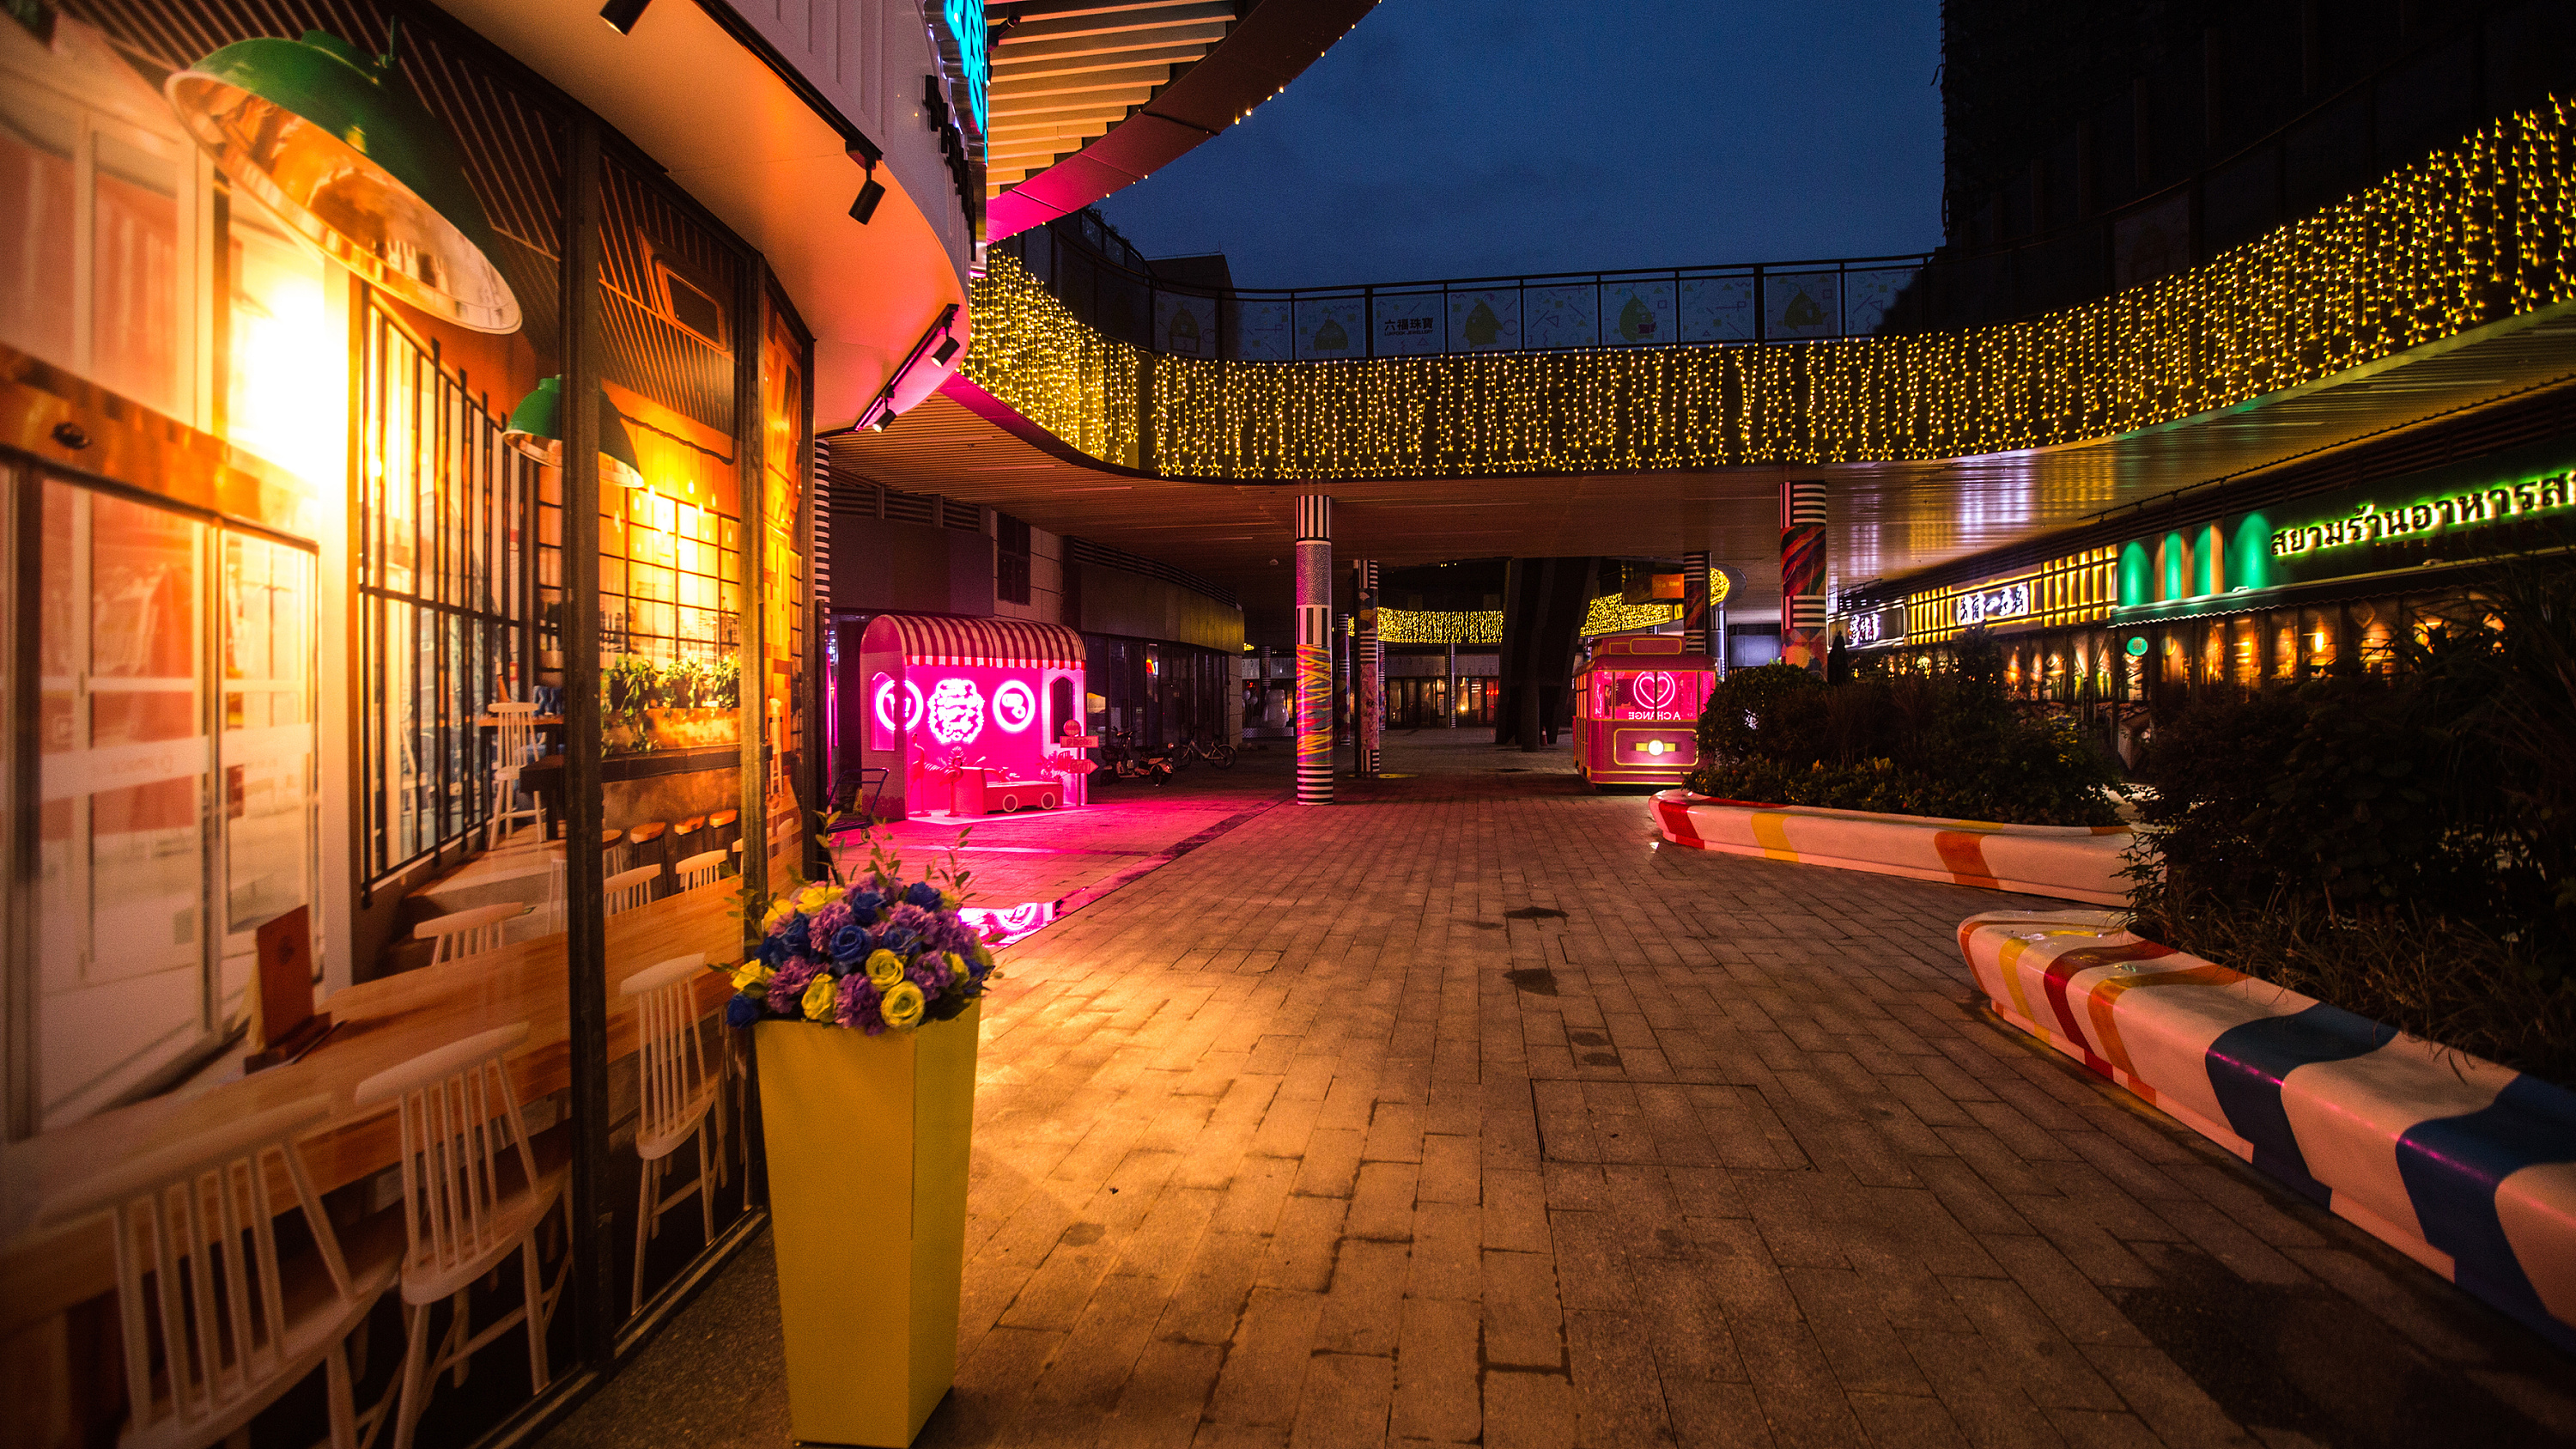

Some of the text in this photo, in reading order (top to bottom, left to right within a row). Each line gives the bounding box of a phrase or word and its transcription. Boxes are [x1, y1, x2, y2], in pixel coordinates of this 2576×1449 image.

[1384, 318, 1434, 331] 六福珠寶
[2269, 470, 2576, 556] สยามร้านอาหารส
